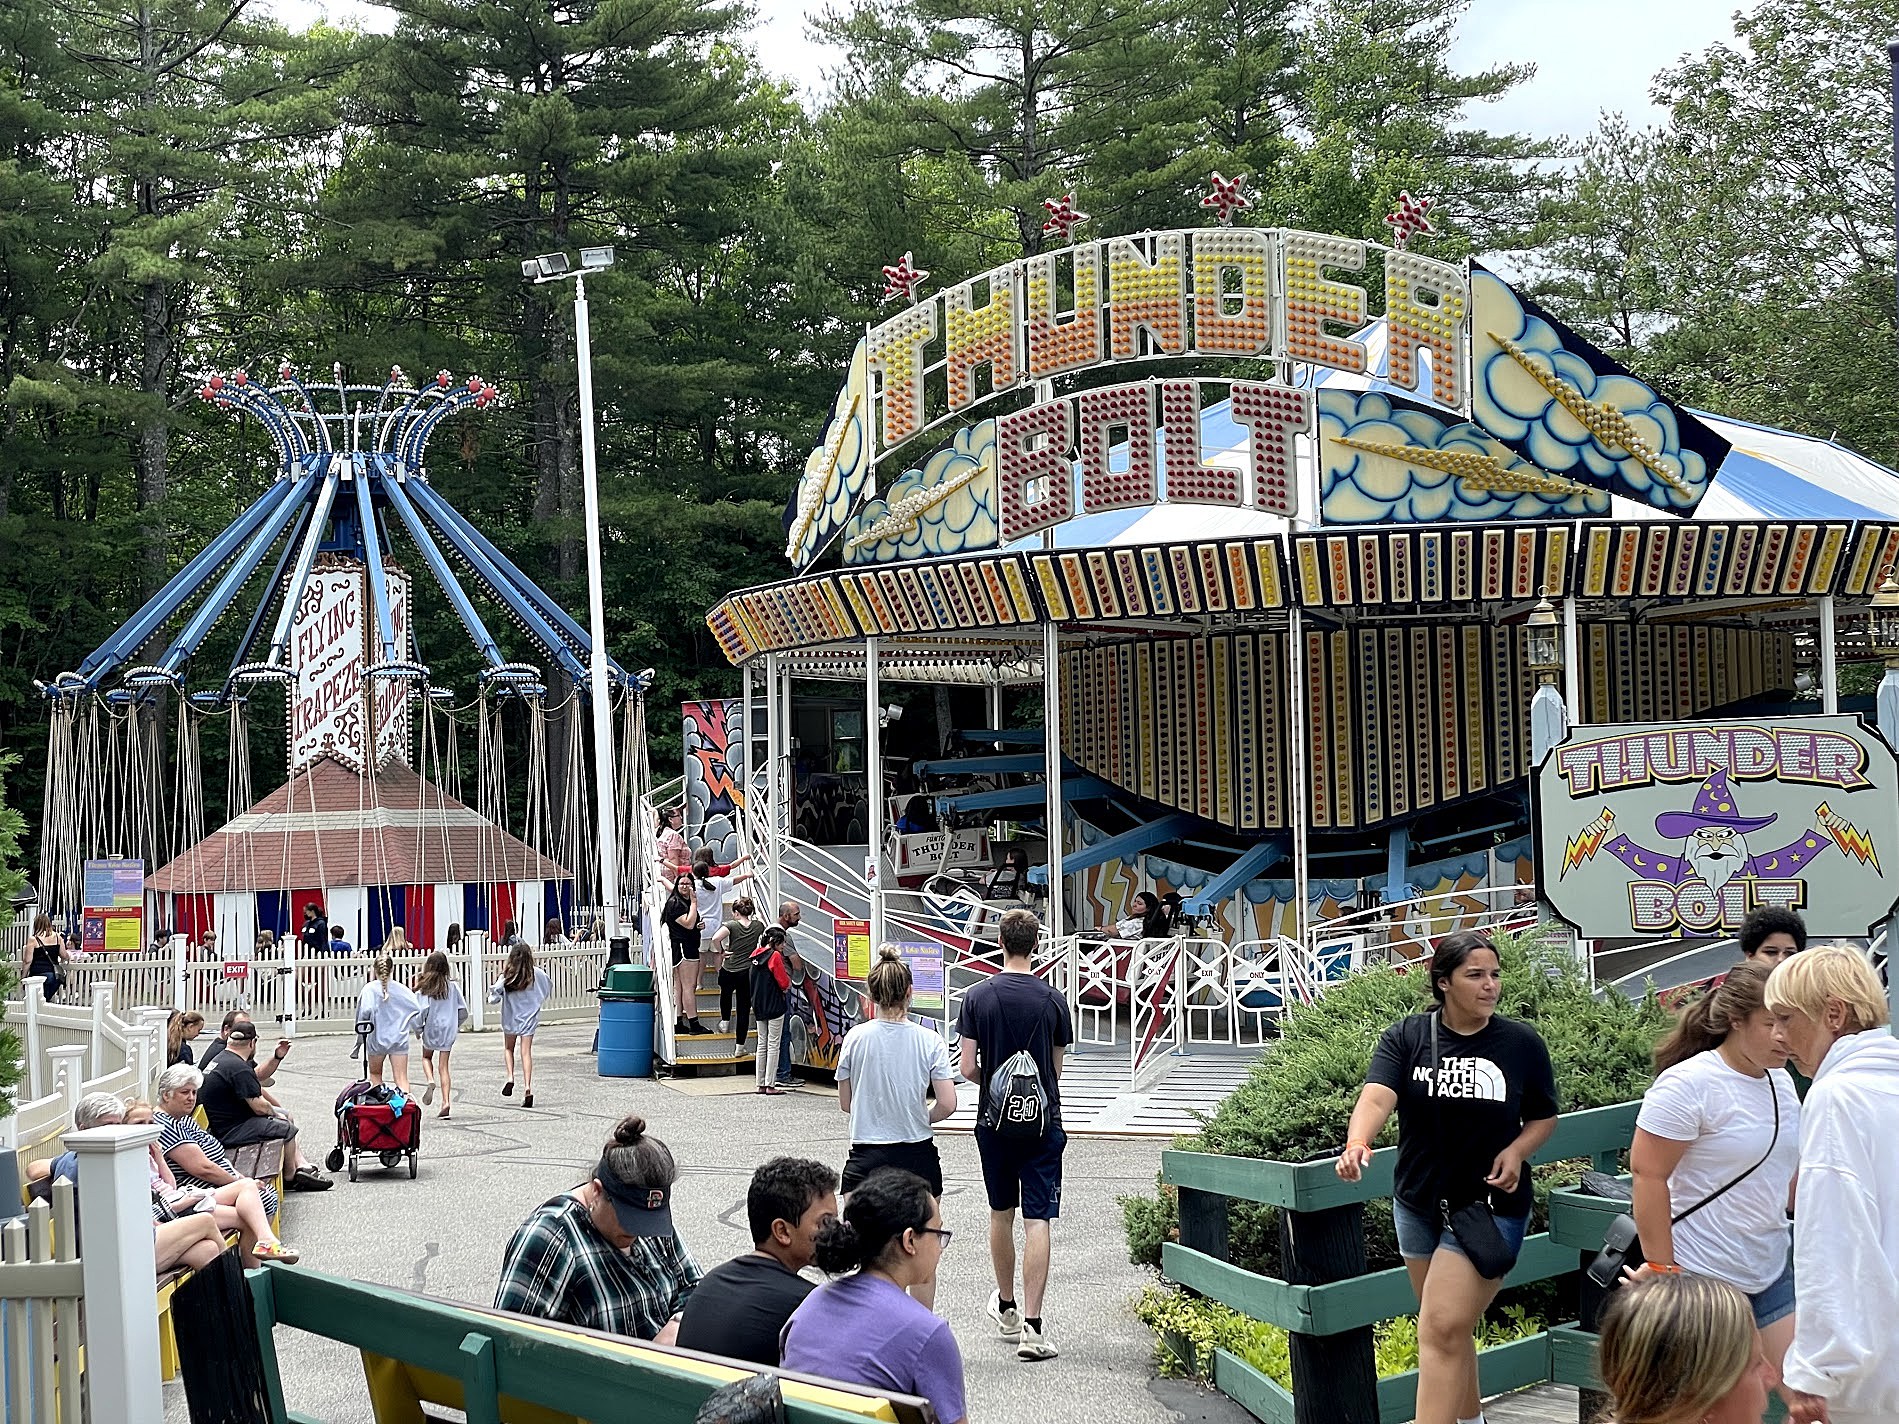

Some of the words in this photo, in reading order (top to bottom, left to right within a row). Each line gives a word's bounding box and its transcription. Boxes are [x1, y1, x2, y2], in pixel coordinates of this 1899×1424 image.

[866, 227, 1471, 449] THUNDER
[997, 377, 1313, 543] BOLT
[298, 590, 355, 670] FLYING
[292, 653, 361, 742] TRAPEZE
[1557, 726, 1874, 798] THUNDER
[930, 851, 960, 862] BOT
[1627, 879, 1808, 932] BOLT
[226, 965, 246, 974] EXIT
[1090, 971, 1101, 979] EXIT
[1201, 969, 1213, 977] EXIT
[1249, 970, 1265, 979] ONLY
[1441, 1056, 1476, 1070] THE
[1007, 1094, 1040, 1123] 20
